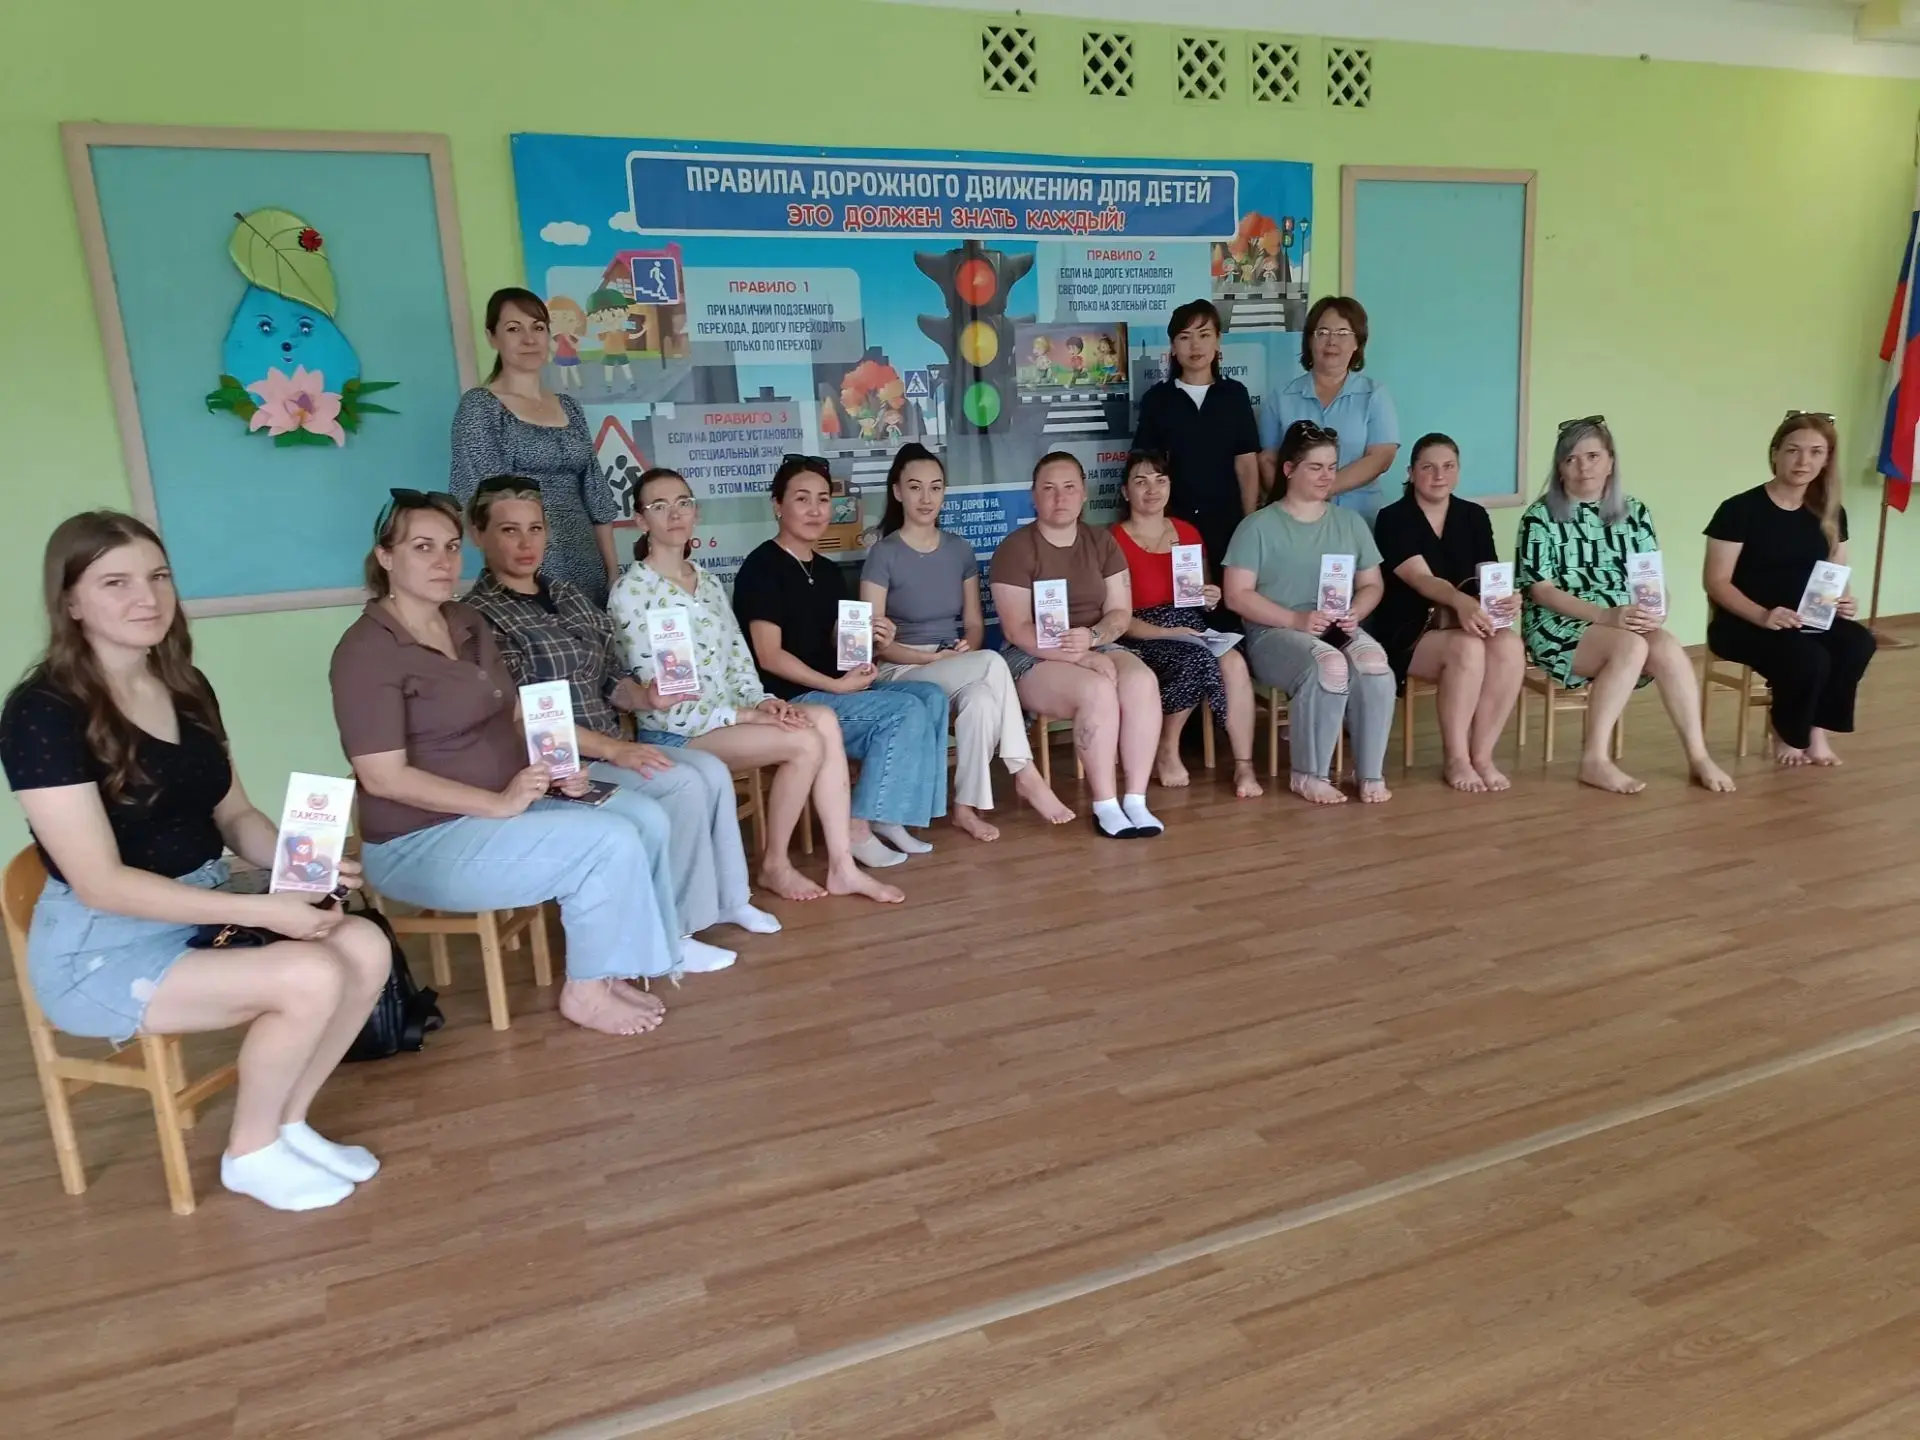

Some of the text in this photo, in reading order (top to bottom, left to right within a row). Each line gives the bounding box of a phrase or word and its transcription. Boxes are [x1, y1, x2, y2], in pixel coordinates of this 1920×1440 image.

[686, 166, 1212, 207] ПРАВИЛА ДОРОЖНОГО ДВИЖЕНИЯ ДЛЯ ДЕТЕЙ
[787, 203, 1126, 236] ЭТО ДОЛЖЕН ЗНАТЬ КАЖДЫЙ!
[1087, 250, 1156, 261] ПРАВИЛО 2
[1060, 268, 1173, 279] ЕСЛИ НА ДОРОГЕ УСТАНОВЛЕН
[729, 281, 809, 293] ПРАВИЛО 1
[1058, 283, 1176, 295] СВЕТОФОР, ДОРОГУ ПЕРЕХОДЯТ
[707, 304, 834, 316] ПРИ НАЛИЧИИ ПОДЗЕМНОГО
[1068, 299, 1167, 311] ТОЛЬКО НА ЗЕЛЕНЫЙ СВЕТ
[751, 322, 787, 335] ДОРОГУ
[788, 321, 846, 334] ПЕРЕХОДИТЬ
[725, 339, 824, 352] ТОЛЬКО ПО ПЕРЕХОДУ
[704, 412, 788, 425] ПРАВИЛО 3
[668, 428, 804, 444] ЕСЛИ НА ДОРОГЕ УСТАНОВЛЕН
[689, 446, 784, 461] СПЕЦИАЛЬНЫЙ ЗНАК
[713, 464, 766, 477] ПЕРЕХОДЯТ
[1088, 469, 1098, 479] НА
[710, 484, 716, 494] В
[718, 483, 742, 494] ЭТОМ
[962, 498, 990, 511] ДОРОГУ
[991, 498, 1000, 508] НА
[961, 510, 1005, 523] ЗАПРЕЩЕНО!
[969, 524, 983, 535] ЕГО
[984, 523, 1008, 534] НУЖНО
[709, 537, 717, 548] 6
